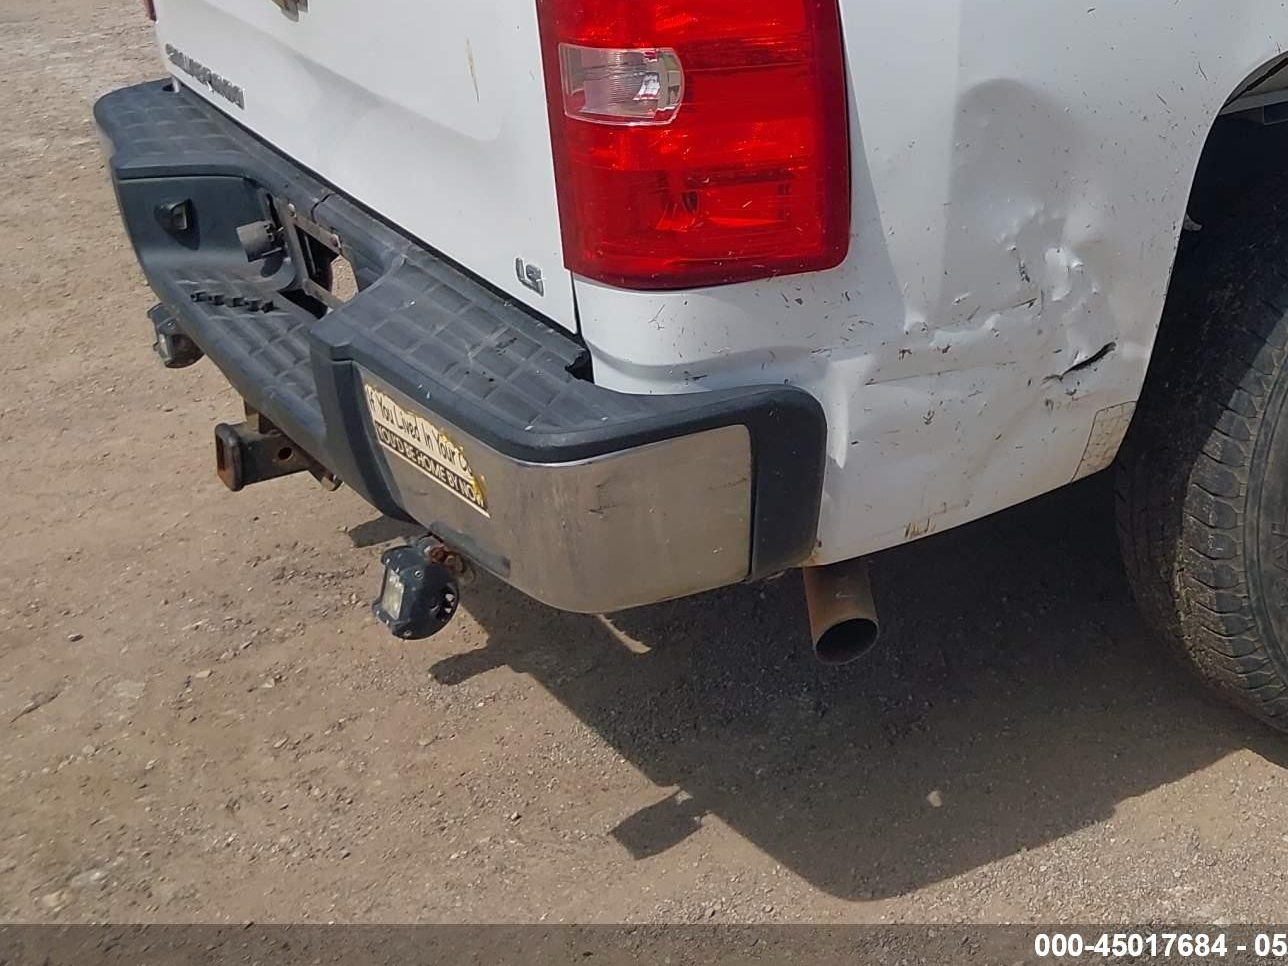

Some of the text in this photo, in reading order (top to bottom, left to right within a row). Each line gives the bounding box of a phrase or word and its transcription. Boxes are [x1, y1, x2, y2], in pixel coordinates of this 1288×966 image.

[515, 257, 544, 297] LS
[377, 395, 395, 424] You
[393, 405, 422, 442] Lived
[432, 429, 456, 465] Your
[416, 450, 448, 483] HOME
